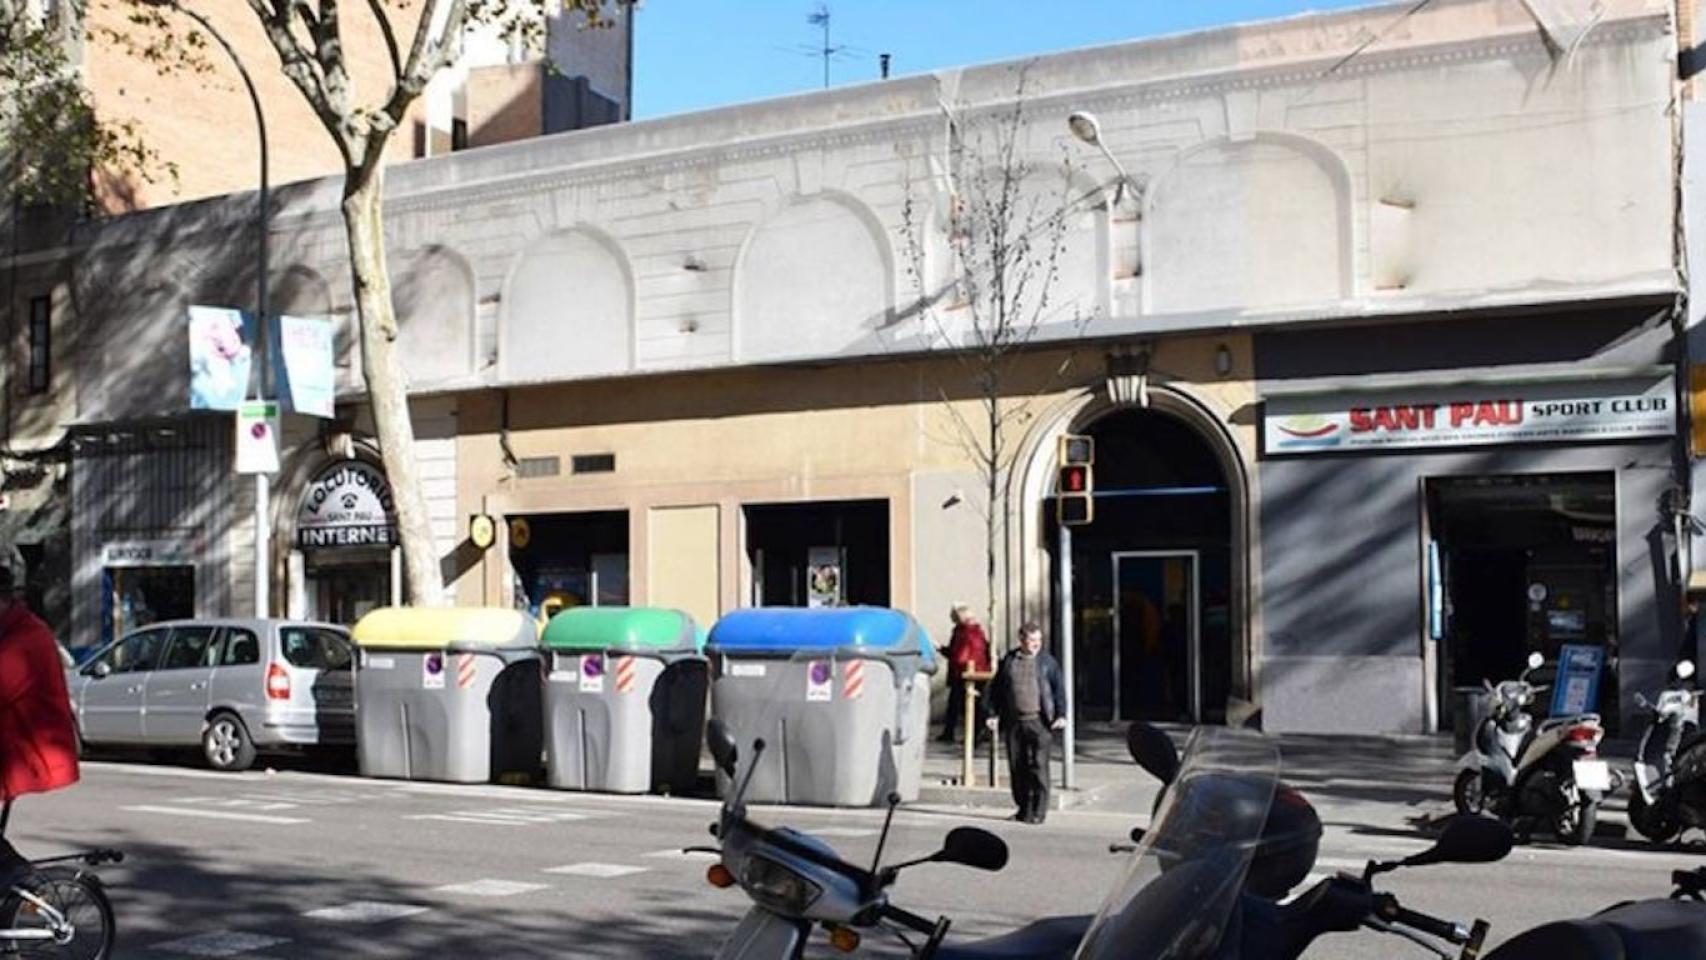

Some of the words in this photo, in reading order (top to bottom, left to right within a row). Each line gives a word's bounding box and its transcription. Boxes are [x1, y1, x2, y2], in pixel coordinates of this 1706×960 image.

[1350, 404, 1438, 432] SANT
[1450, 399, 1523, 428] PAU
[1532, 401, 1601, 417] SPORT
[1611, 397, 1667, 414] CLUB
[307, 467, 392, 515] LOCUTORIO
